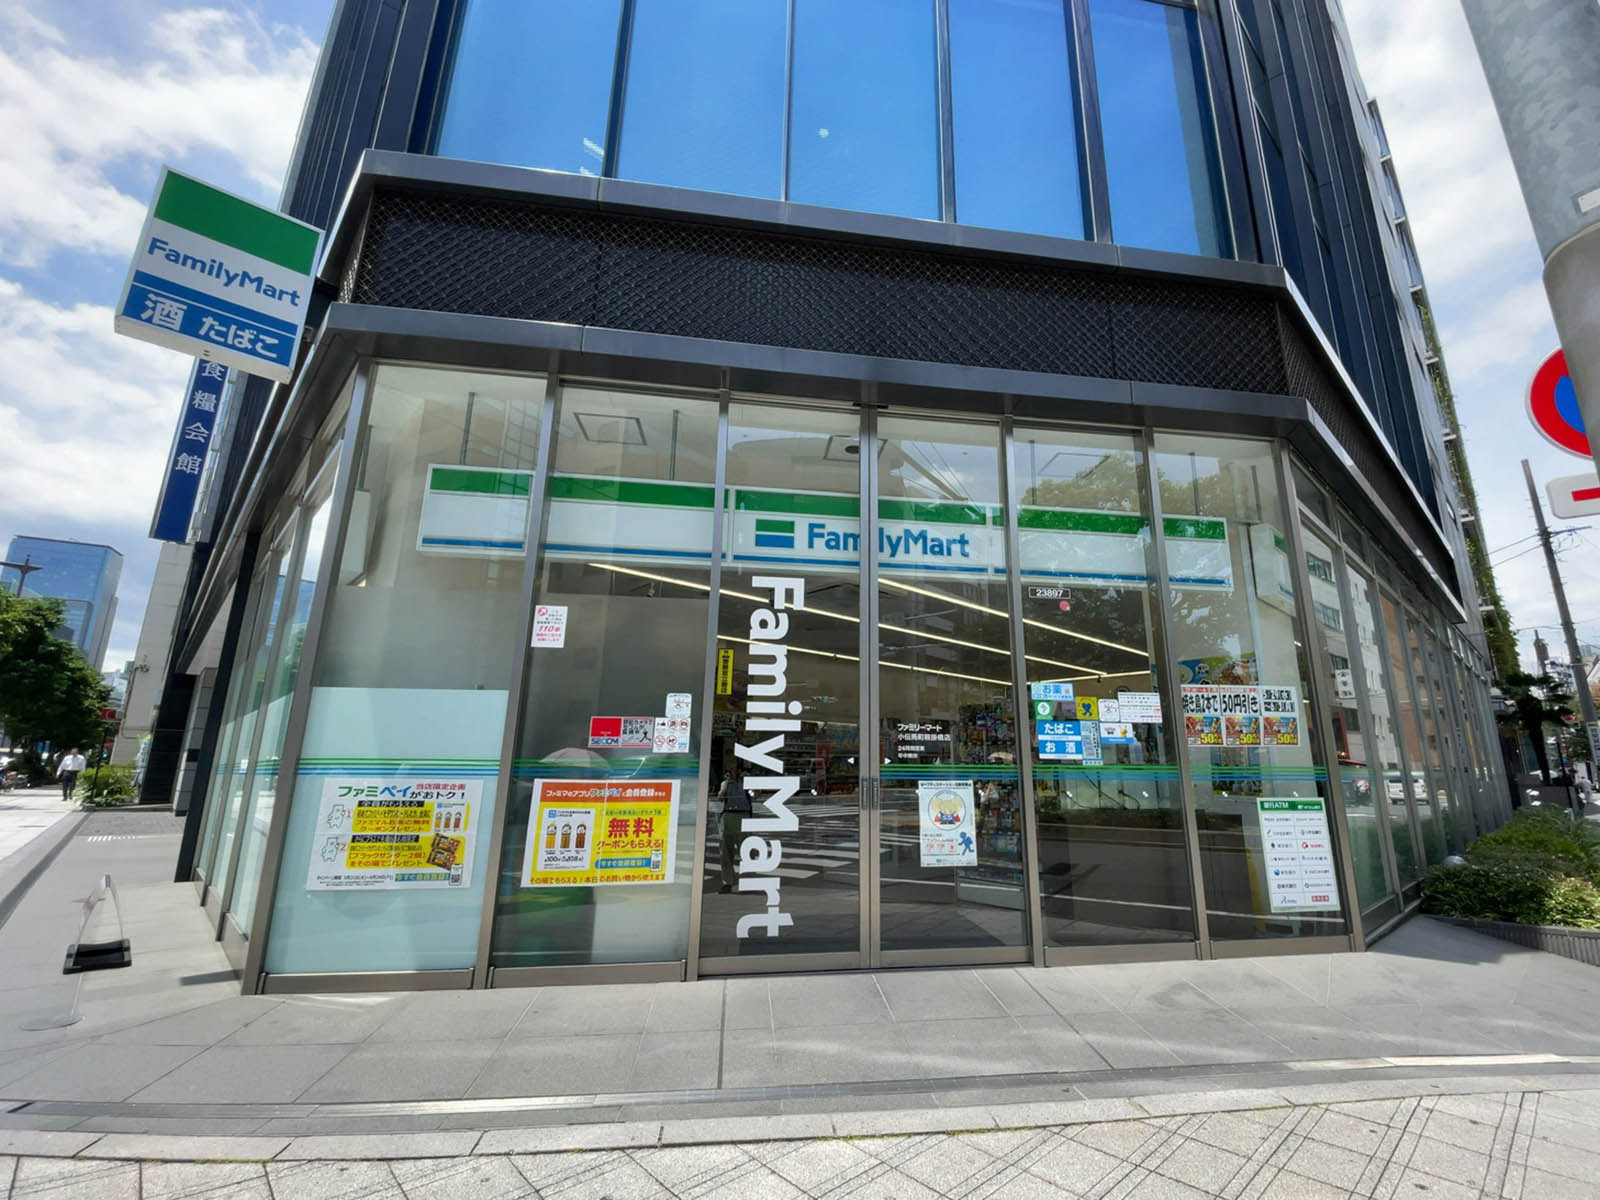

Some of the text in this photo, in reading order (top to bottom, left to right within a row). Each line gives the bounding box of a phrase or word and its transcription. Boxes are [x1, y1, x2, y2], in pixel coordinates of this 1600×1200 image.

[147, 237, 300, 307] FamilyMart
[141, 293, 279, 359] 酒 たばこ
[807, 522, 970, 558] FamlyMart
[1036, 588, 1064, 598] 23897
[897, 723, 943, 732] ファミリーマート
[1044, 722, 1075, 734] たばこ
[591, 737, 619, 745] SECOM
[734, 576, 805, 939] FamilyMart
[337, 785, 412, 798] ファミペイ
[608, 817, 655, 838] 無料
